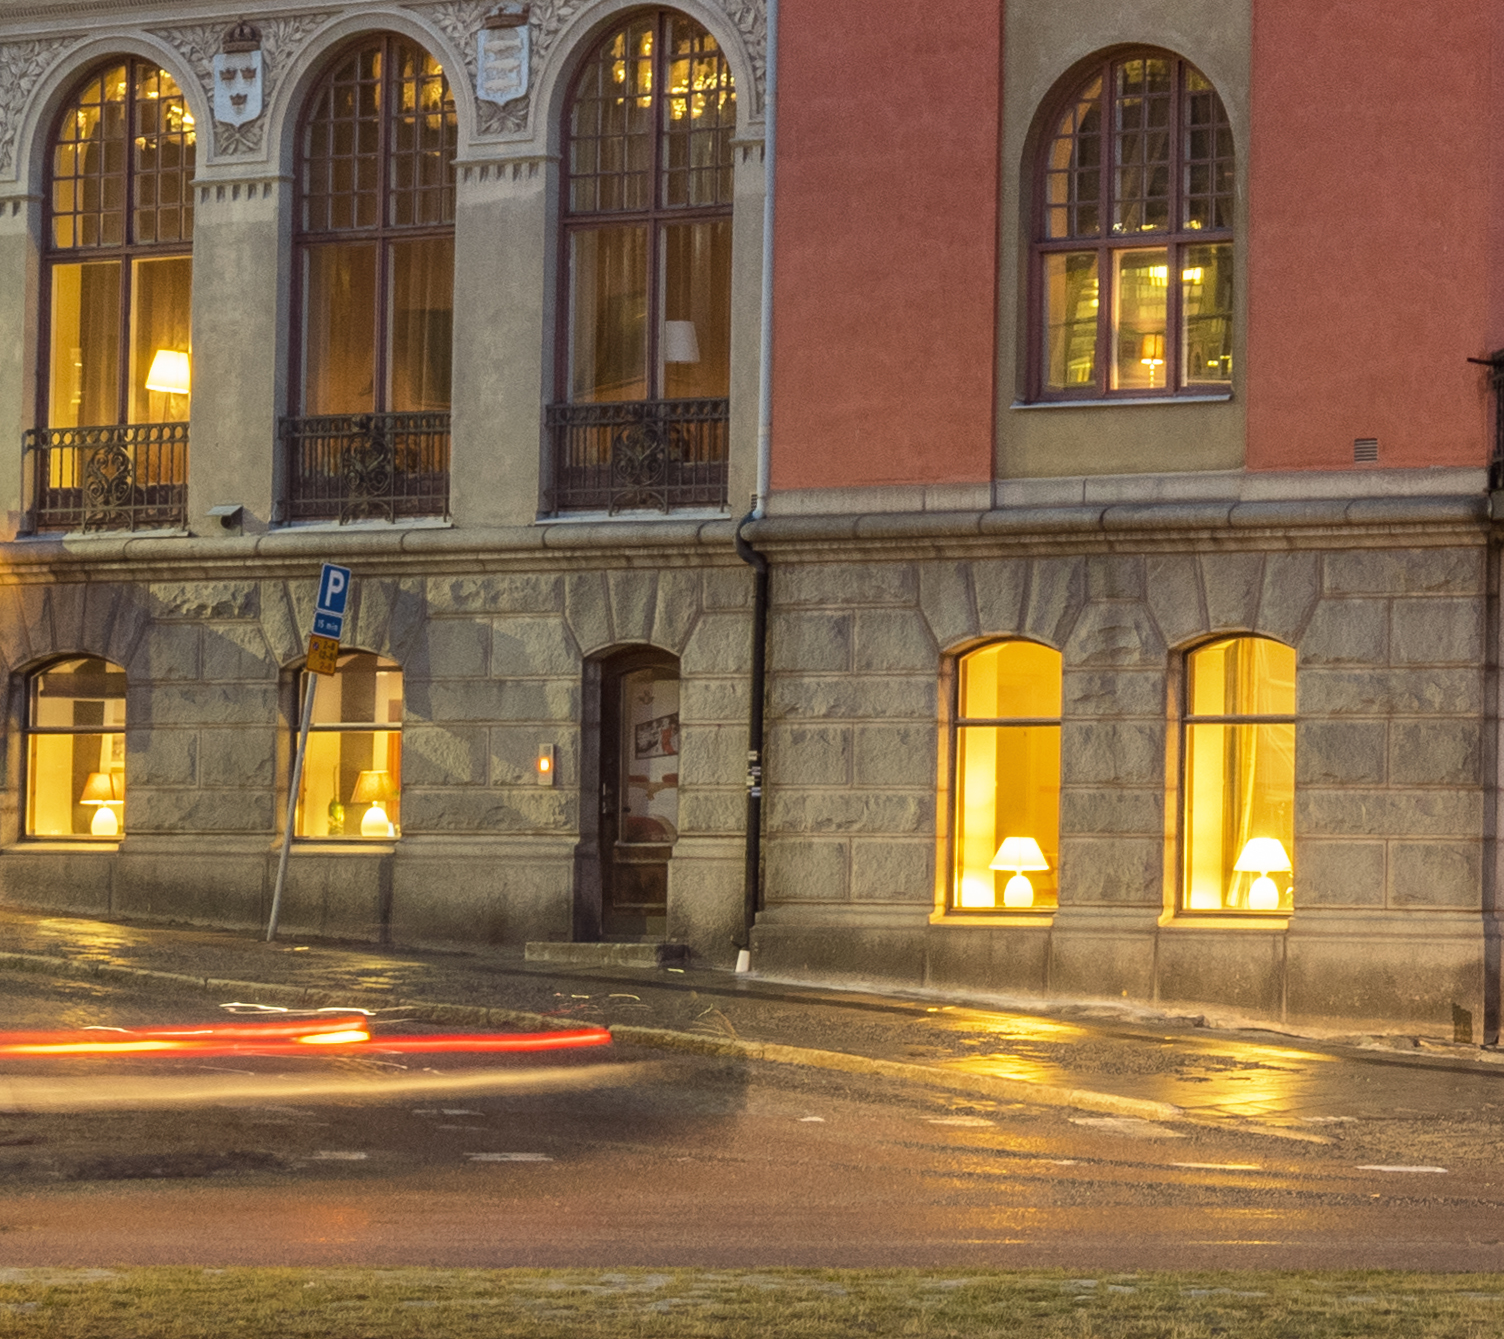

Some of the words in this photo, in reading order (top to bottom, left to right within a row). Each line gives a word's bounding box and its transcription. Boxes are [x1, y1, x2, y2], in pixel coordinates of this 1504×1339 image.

[324, 569, 345, 607] P
[317, 619, 325, 628] 15
[326, 622, 338, 632] min
